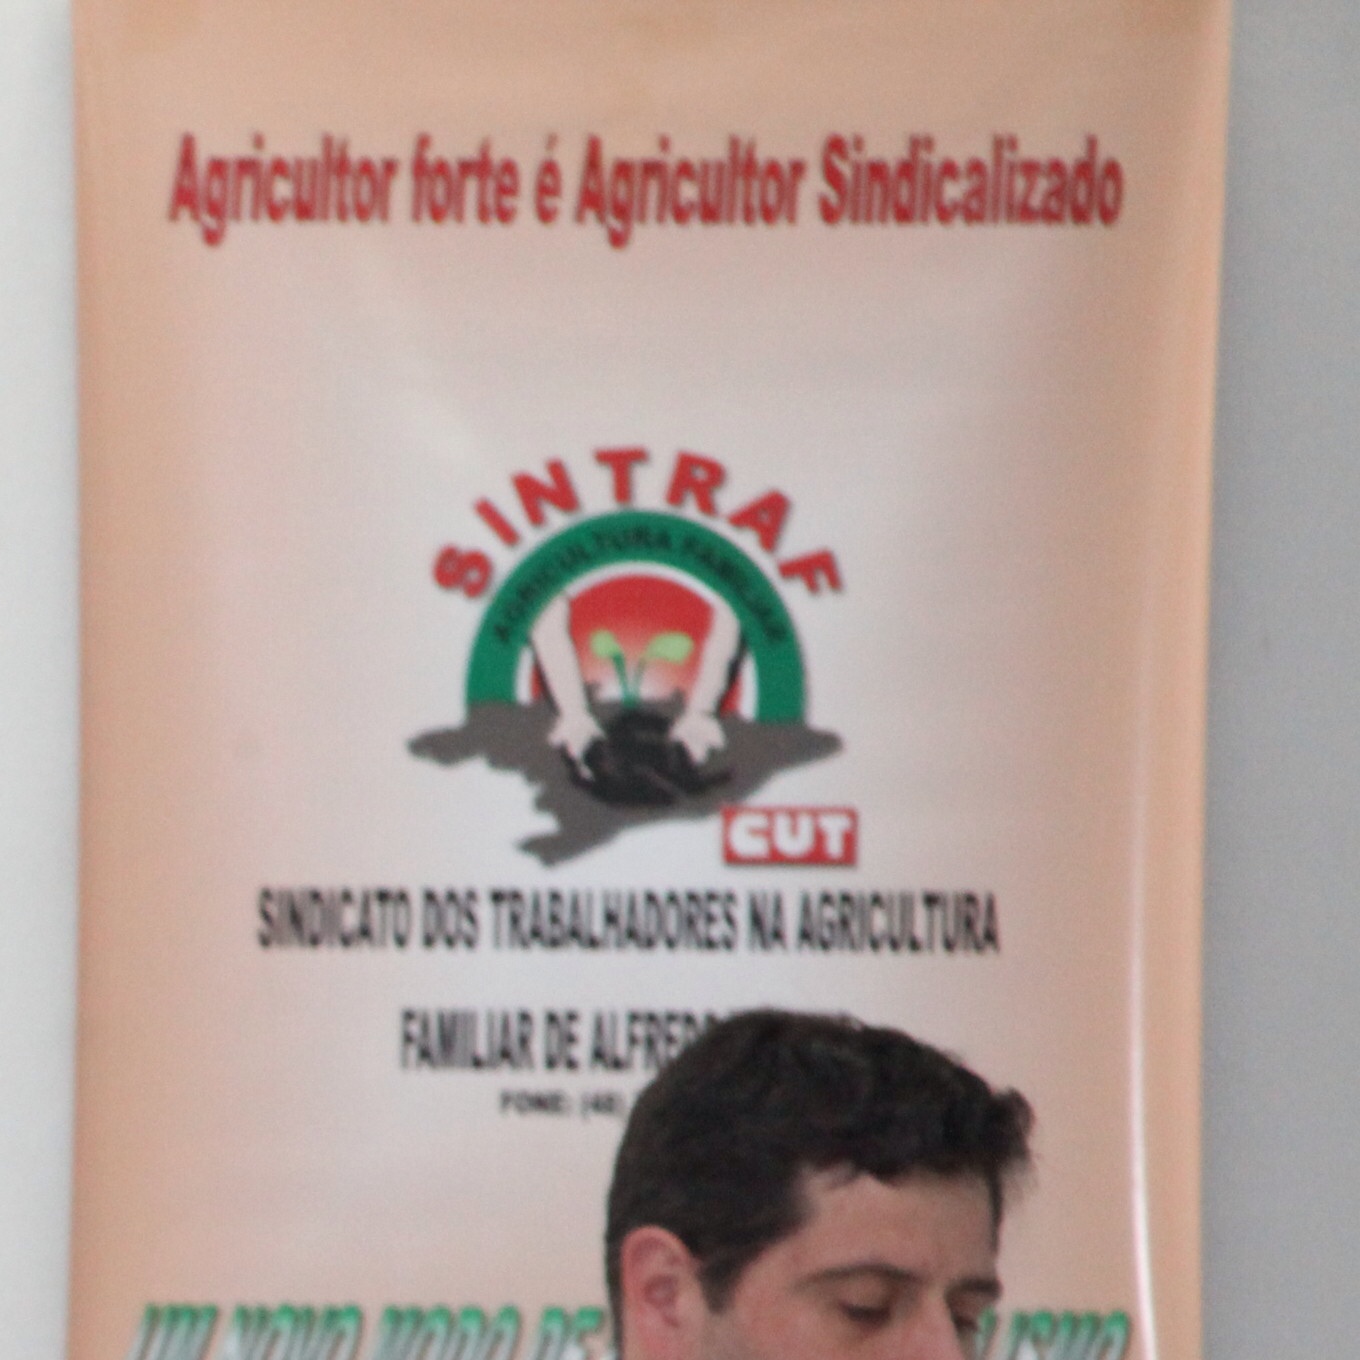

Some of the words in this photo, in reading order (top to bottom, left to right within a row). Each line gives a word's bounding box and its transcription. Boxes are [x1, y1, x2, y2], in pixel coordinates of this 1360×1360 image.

[167, 132, 399, 247] Agricultor
[410, 132, 520, 224] forte
[533, 132, 562, 225] é
[574, 133, 807, 249] Agricultor
[818, 133, 1125, 226] Sindicalizado
[432, 446, 844, 600] SINTRAF
[726, 810, 853, 860] CUT
[257, 887, 412, 949] SINDICATO
[422, 888, 478, 949] DOS
[489, 888, 737, 951] TRABALHADORES
[746, 889, 785, 951] NA
[796, 890, 1000, 952] AGRICULTURA
[401, 1009, 534, 1070] FAMILIAR
[544, 1010, 579, 1070] DE
[589, 1010, 712, 1070] ALFRED
